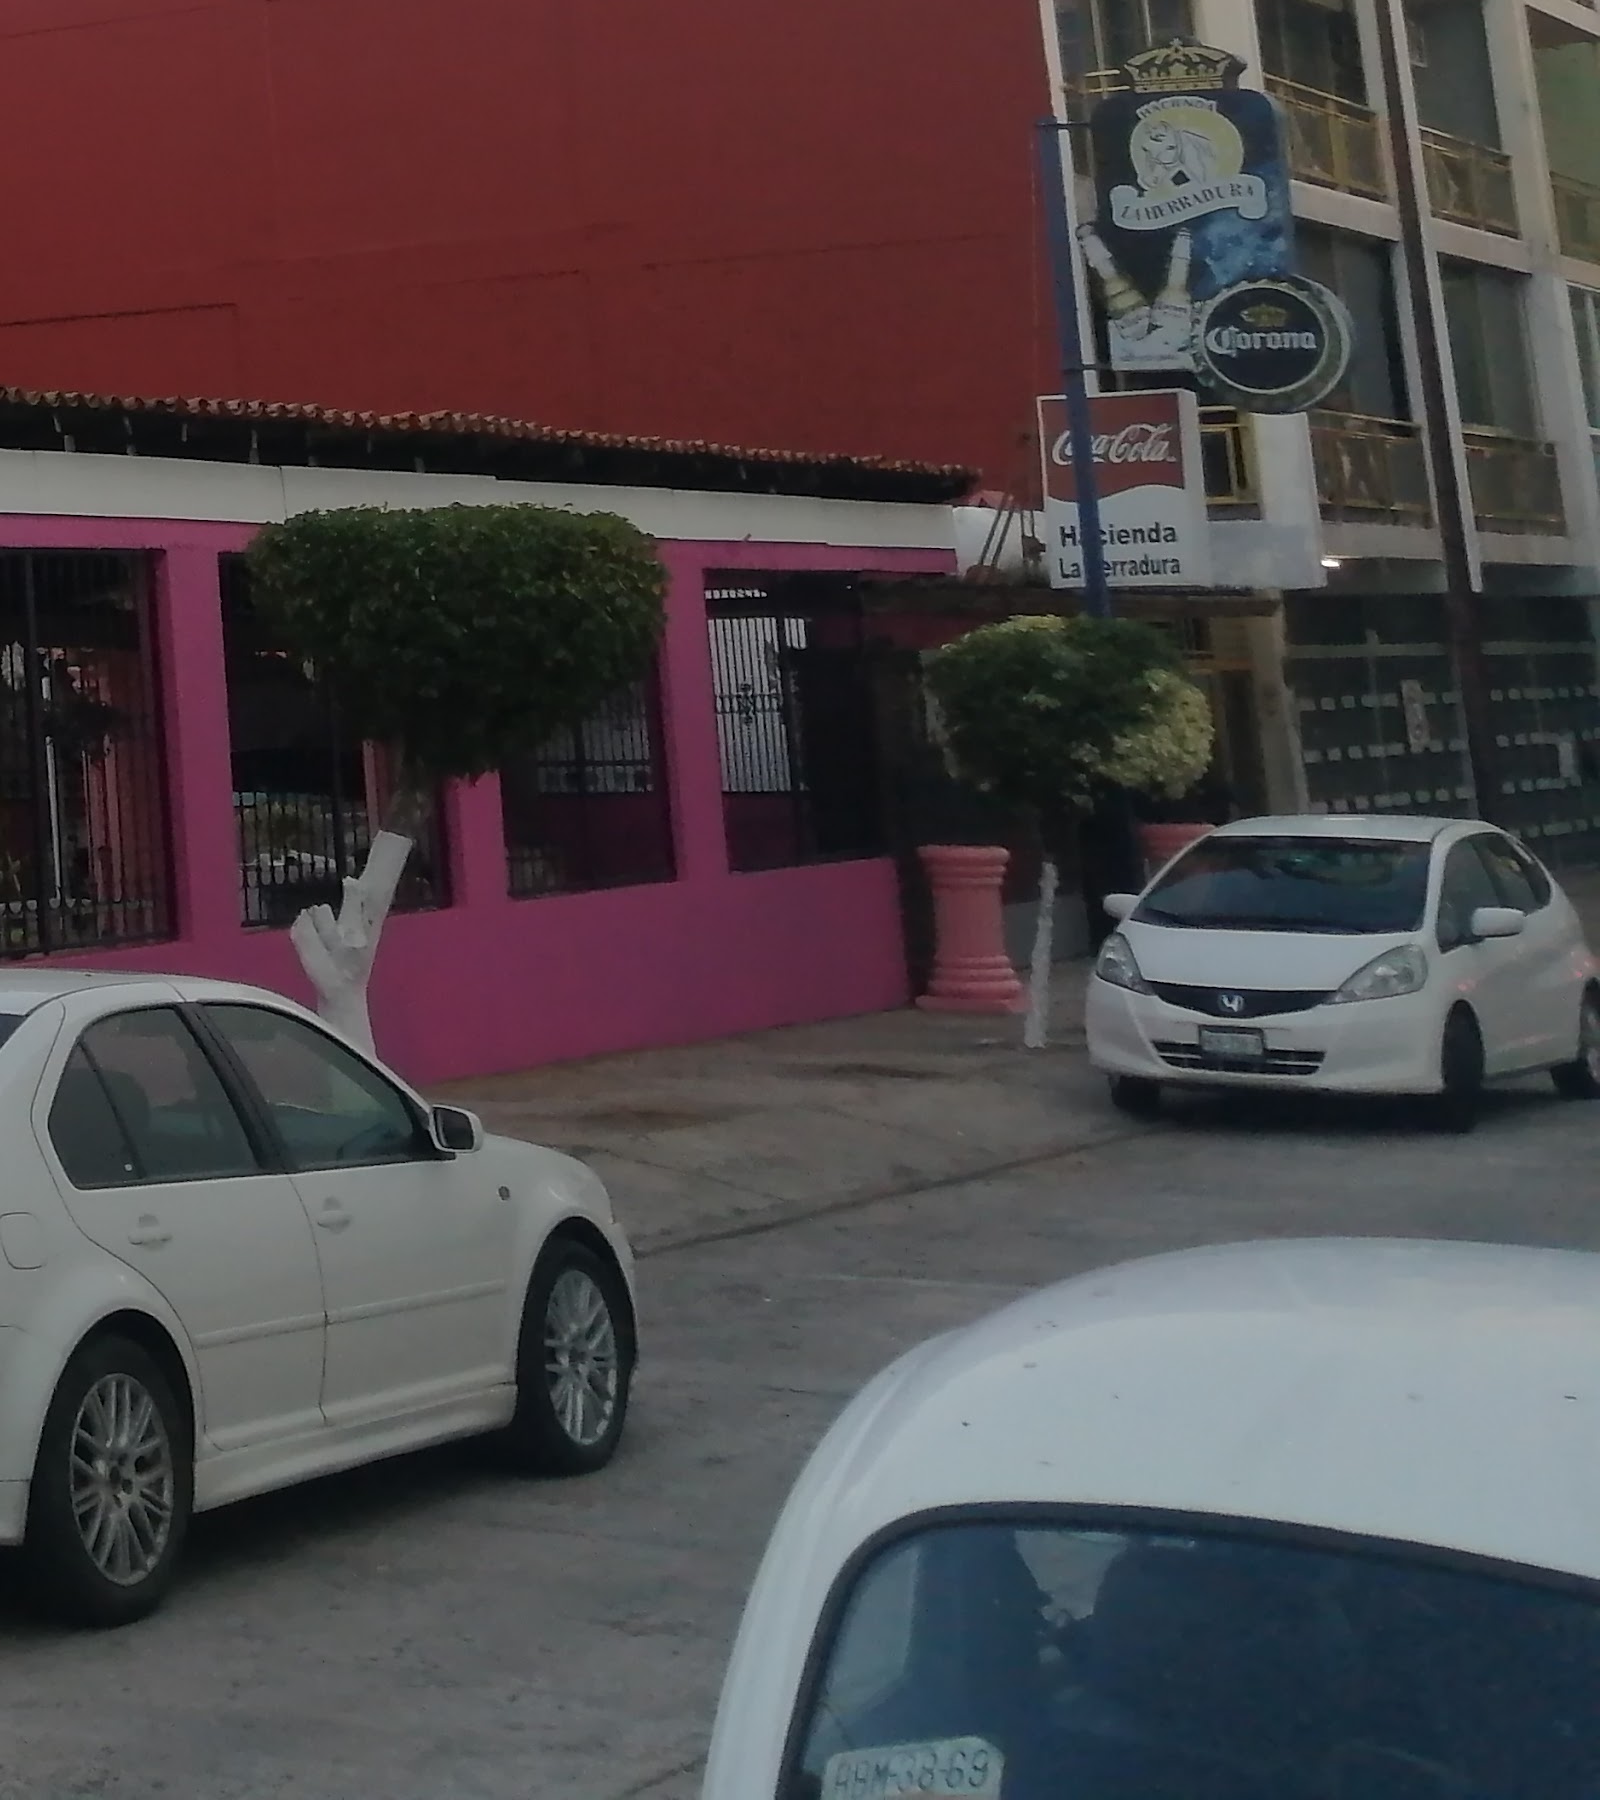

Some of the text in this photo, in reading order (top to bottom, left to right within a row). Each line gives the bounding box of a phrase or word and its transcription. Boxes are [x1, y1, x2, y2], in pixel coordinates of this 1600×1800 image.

[1206, 326, 1316, 357] Corona
[1059, 520, 1177, 548] Hcienda
[1059, 553, 1181, 579] La erradura
